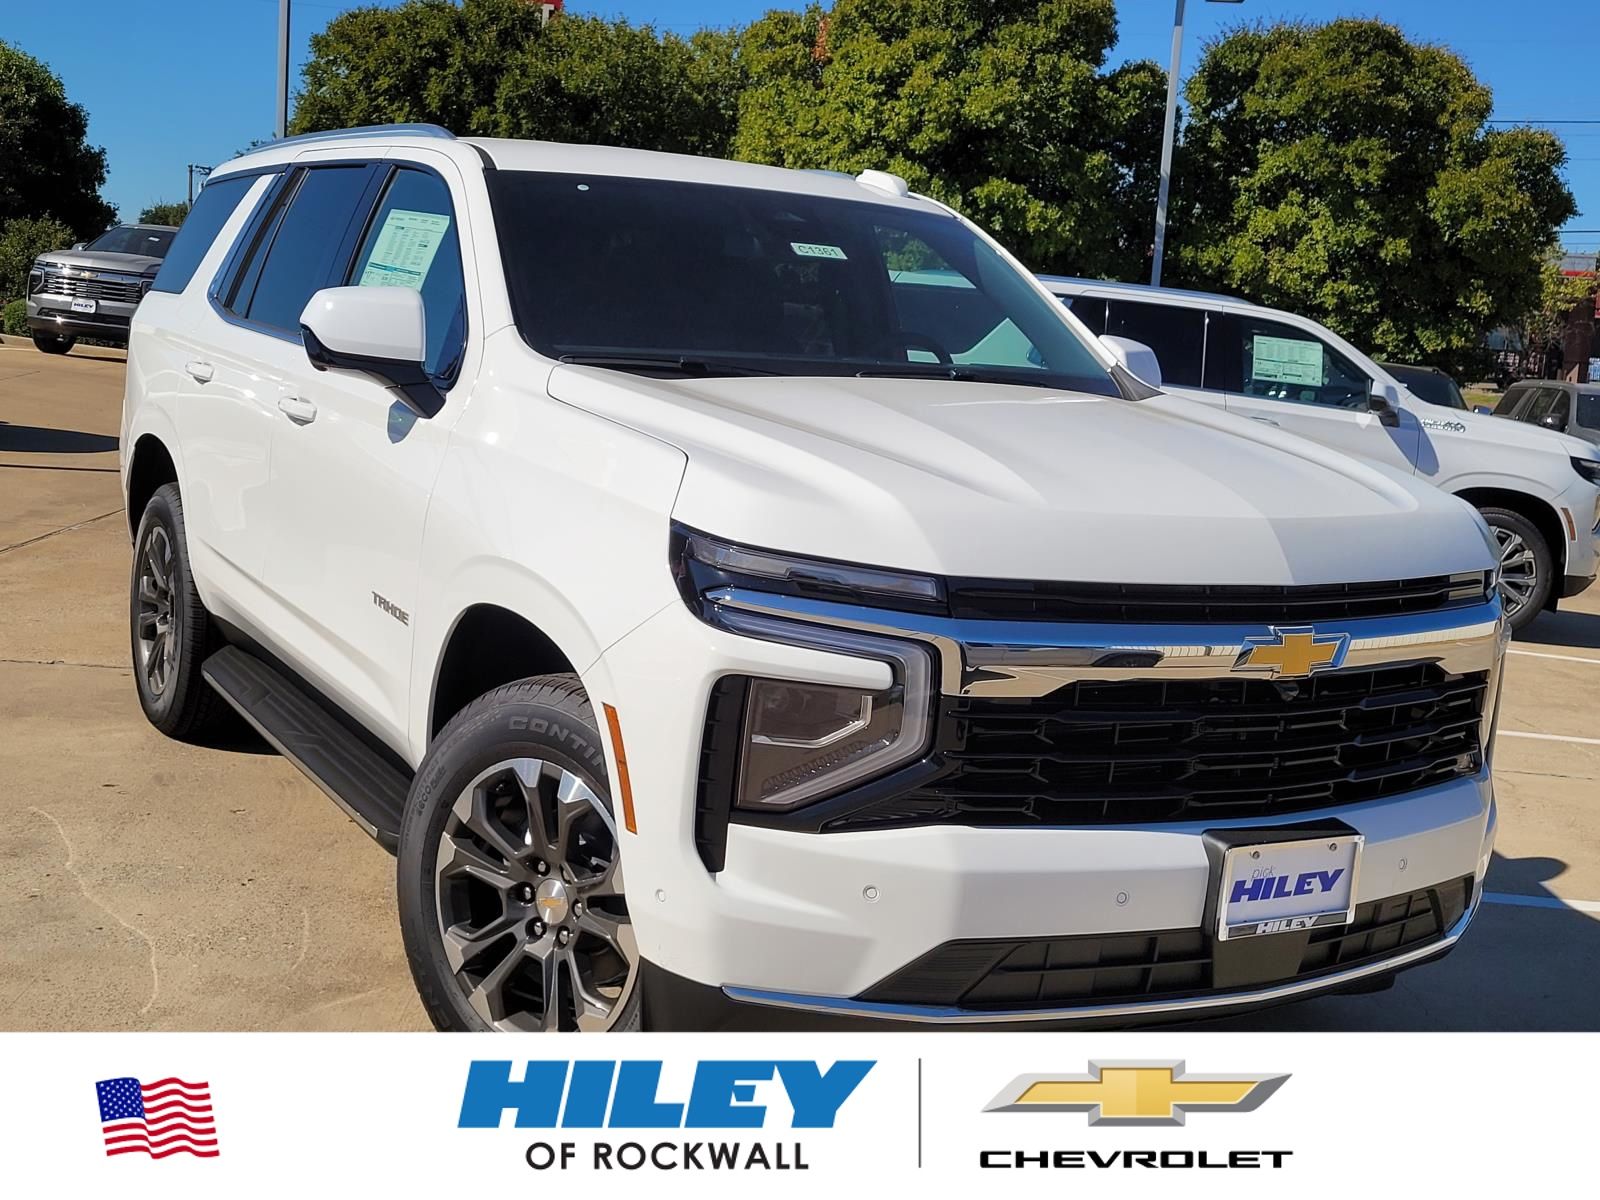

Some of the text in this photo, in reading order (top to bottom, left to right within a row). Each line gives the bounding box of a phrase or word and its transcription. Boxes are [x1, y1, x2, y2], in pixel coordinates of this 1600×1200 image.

[371, 590, 409, 627] TAHOE
[1229, 868, 1345, 904] HILEY
[1251, 865, 1275, 880] pick
[1256, 916, 1319, 935] HILEY
